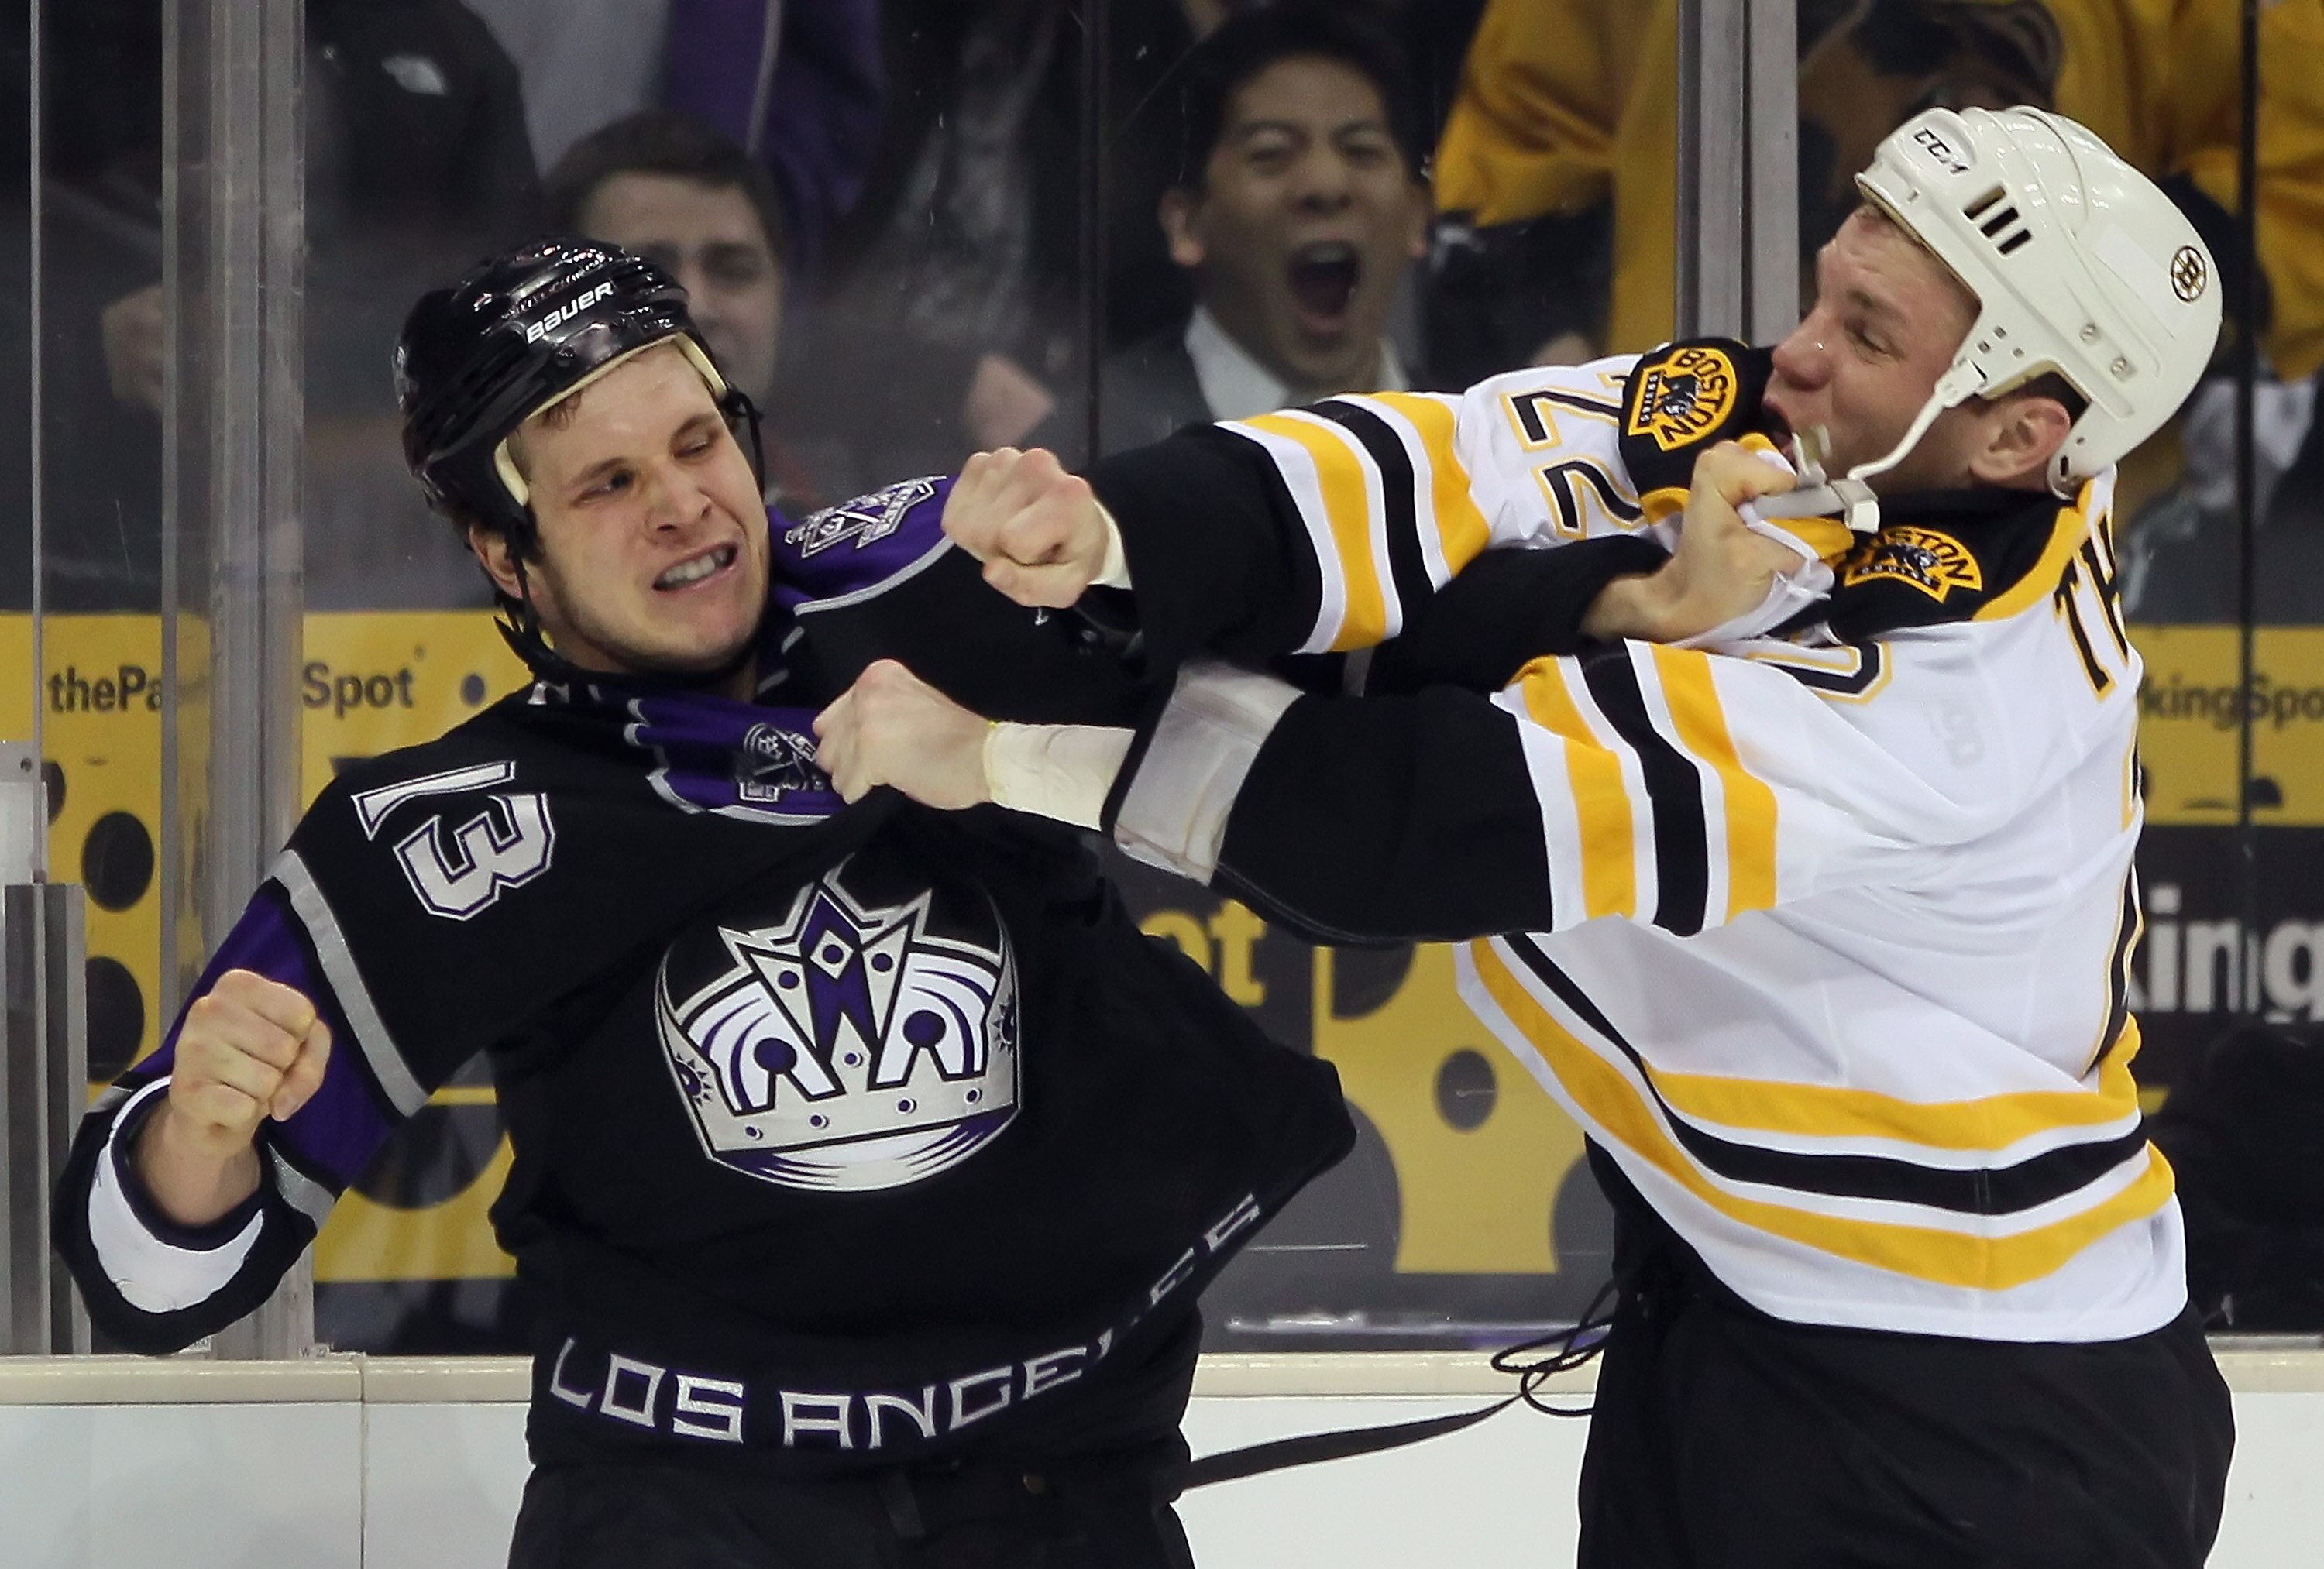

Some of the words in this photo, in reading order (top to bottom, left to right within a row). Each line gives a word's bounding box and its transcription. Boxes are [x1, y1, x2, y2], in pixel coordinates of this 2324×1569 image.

[1661, 349, 1729, 443] BOSTON
[302, 661, 414, 719] Spot
[350, 760, 555, 921] 13
[2129, 884, 2324, 1024] ing
[549, 1337, 744, 1444] LOS
